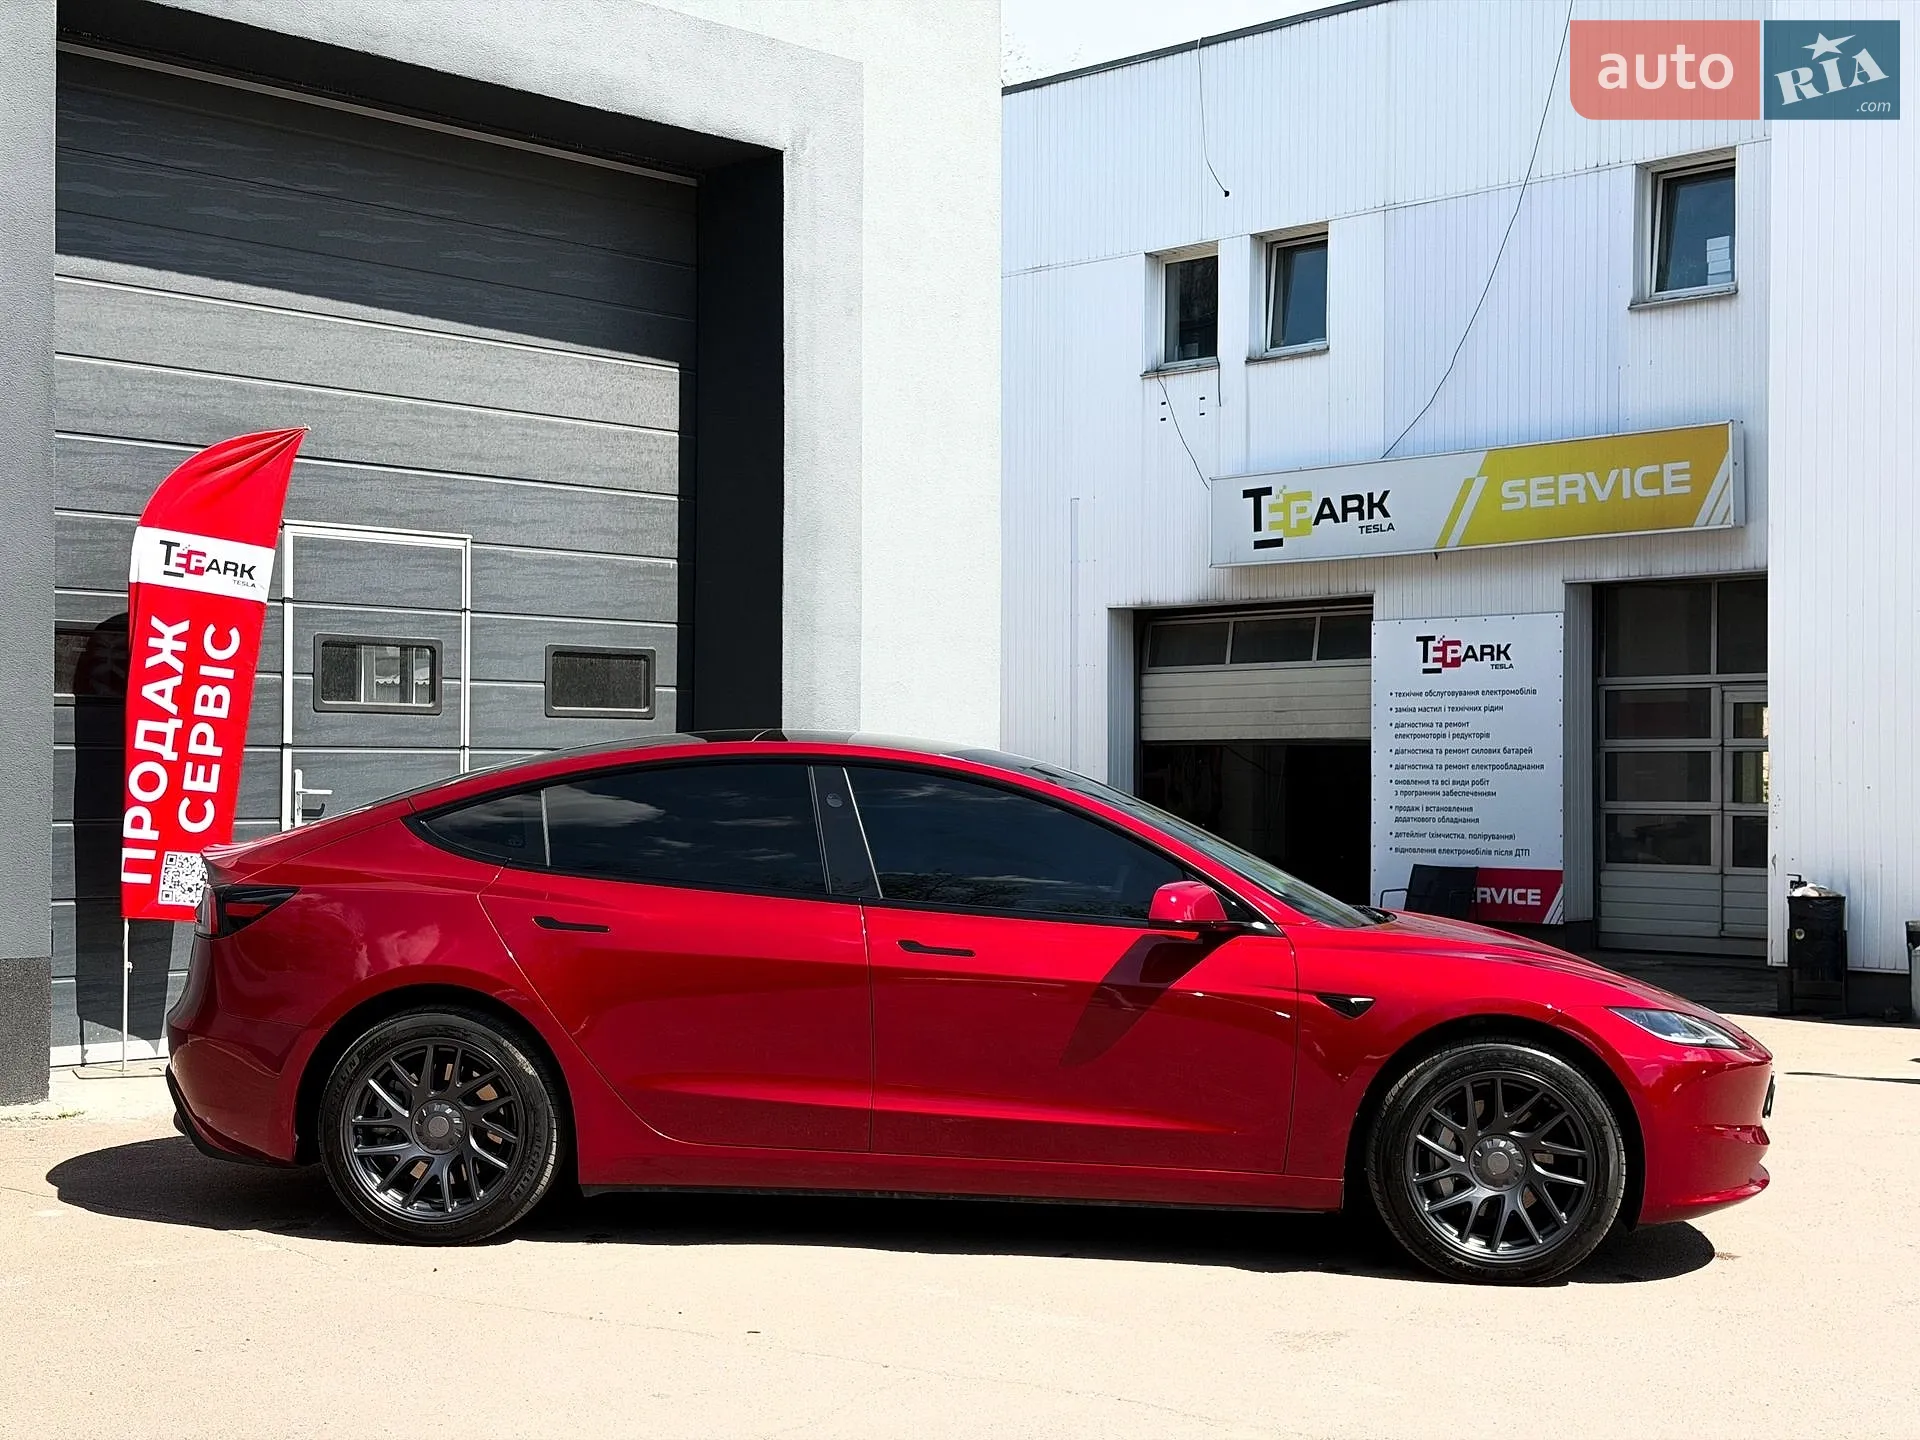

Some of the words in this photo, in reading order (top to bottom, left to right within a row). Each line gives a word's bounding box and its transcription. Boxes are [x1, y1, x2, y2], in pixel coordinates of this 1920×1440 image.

[1502, 461, 1691, 511] SERVICE
[1359, 522, 1395, 535] TESLA
[232, 578, 257, 589] TESLA
[1395, 690, 1423, 698] технічне
[1425, 689, 1479, 698] обслуговування
[1482, 687, 1537, 697] електромобілів
[1395, 705, 1416, 713] заміна
[1484, 704, 1503, 714] рідин
[178, 622, 241, 833] СЕРВІС
[1394, 721, 1433, 729] діагностика
[1445, 721, 1469, 729] ремонт
[1395, 731, 1446, 740] електромоторів
[1452, 731, 1490, 740] редукторів
[121, 615, 190, 884] ПРОДАЖ
[1394, 747, 1433, 755] діагностика
[1503, 746, 1533, 755] батарей
[1394, 763, 1433, 771] діагностика
[1471, 762, 1544, 771] електрообладнання
[1441, 778, 1450, 786] всі
[1471, 778, 1489, 787] робіт
[1400, 790, 1440, 798] програмним
[1395, 805, 1419, 813] продаж
[1394, 816, 1436, 824] додаткового
[1438, 816, 1479, 824] обладнання
[1438, 847, 1492, 857] електромобілів
[1494, 848, 1513, 856] після
[1515, 848, 1530, 857] ДТП
[1473, 887, 1541, 905] RVICE
